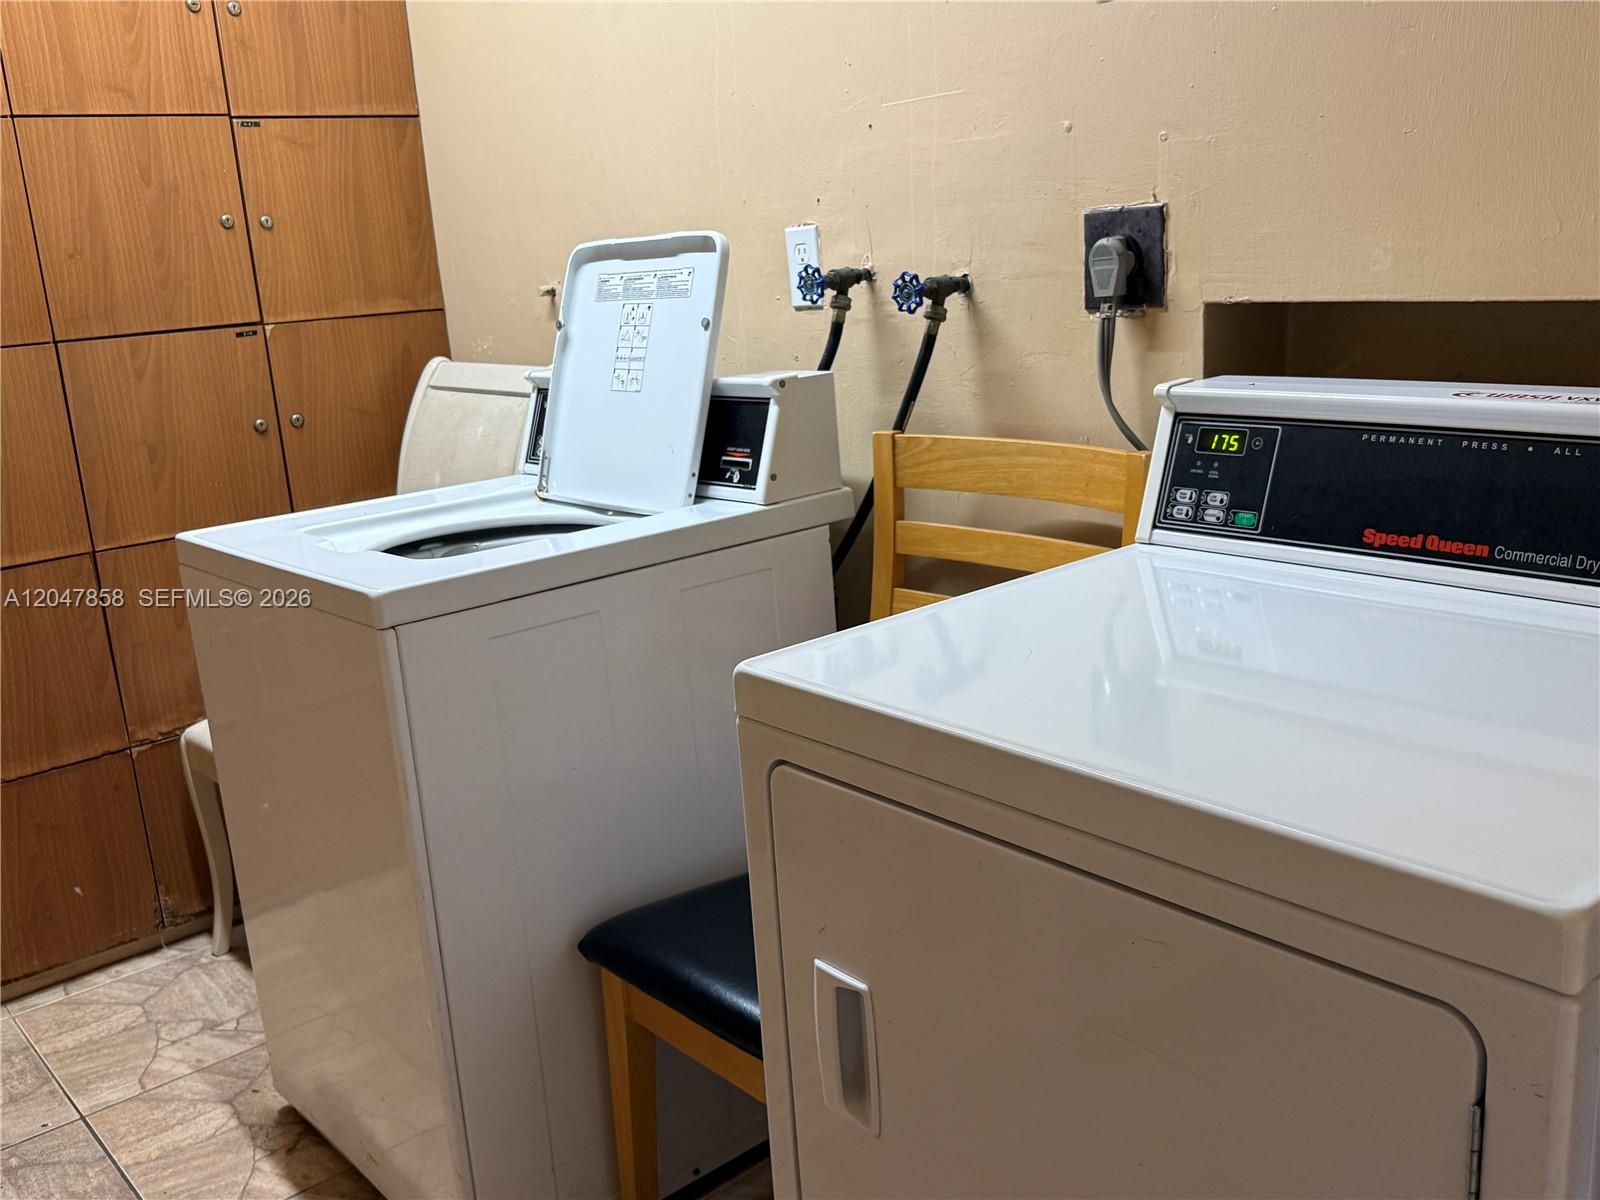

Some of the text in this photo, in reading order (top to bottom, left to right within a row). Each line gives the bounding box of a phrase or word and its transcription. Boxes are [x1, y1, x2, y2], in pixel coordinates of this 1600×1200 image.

[1211, 434, 1239, 451] 175
[1362, 433, 1582, 456] PERMANENT PRESS ALL
[1362, 528, 1600, 575] Speed Queen Commercial Dry
